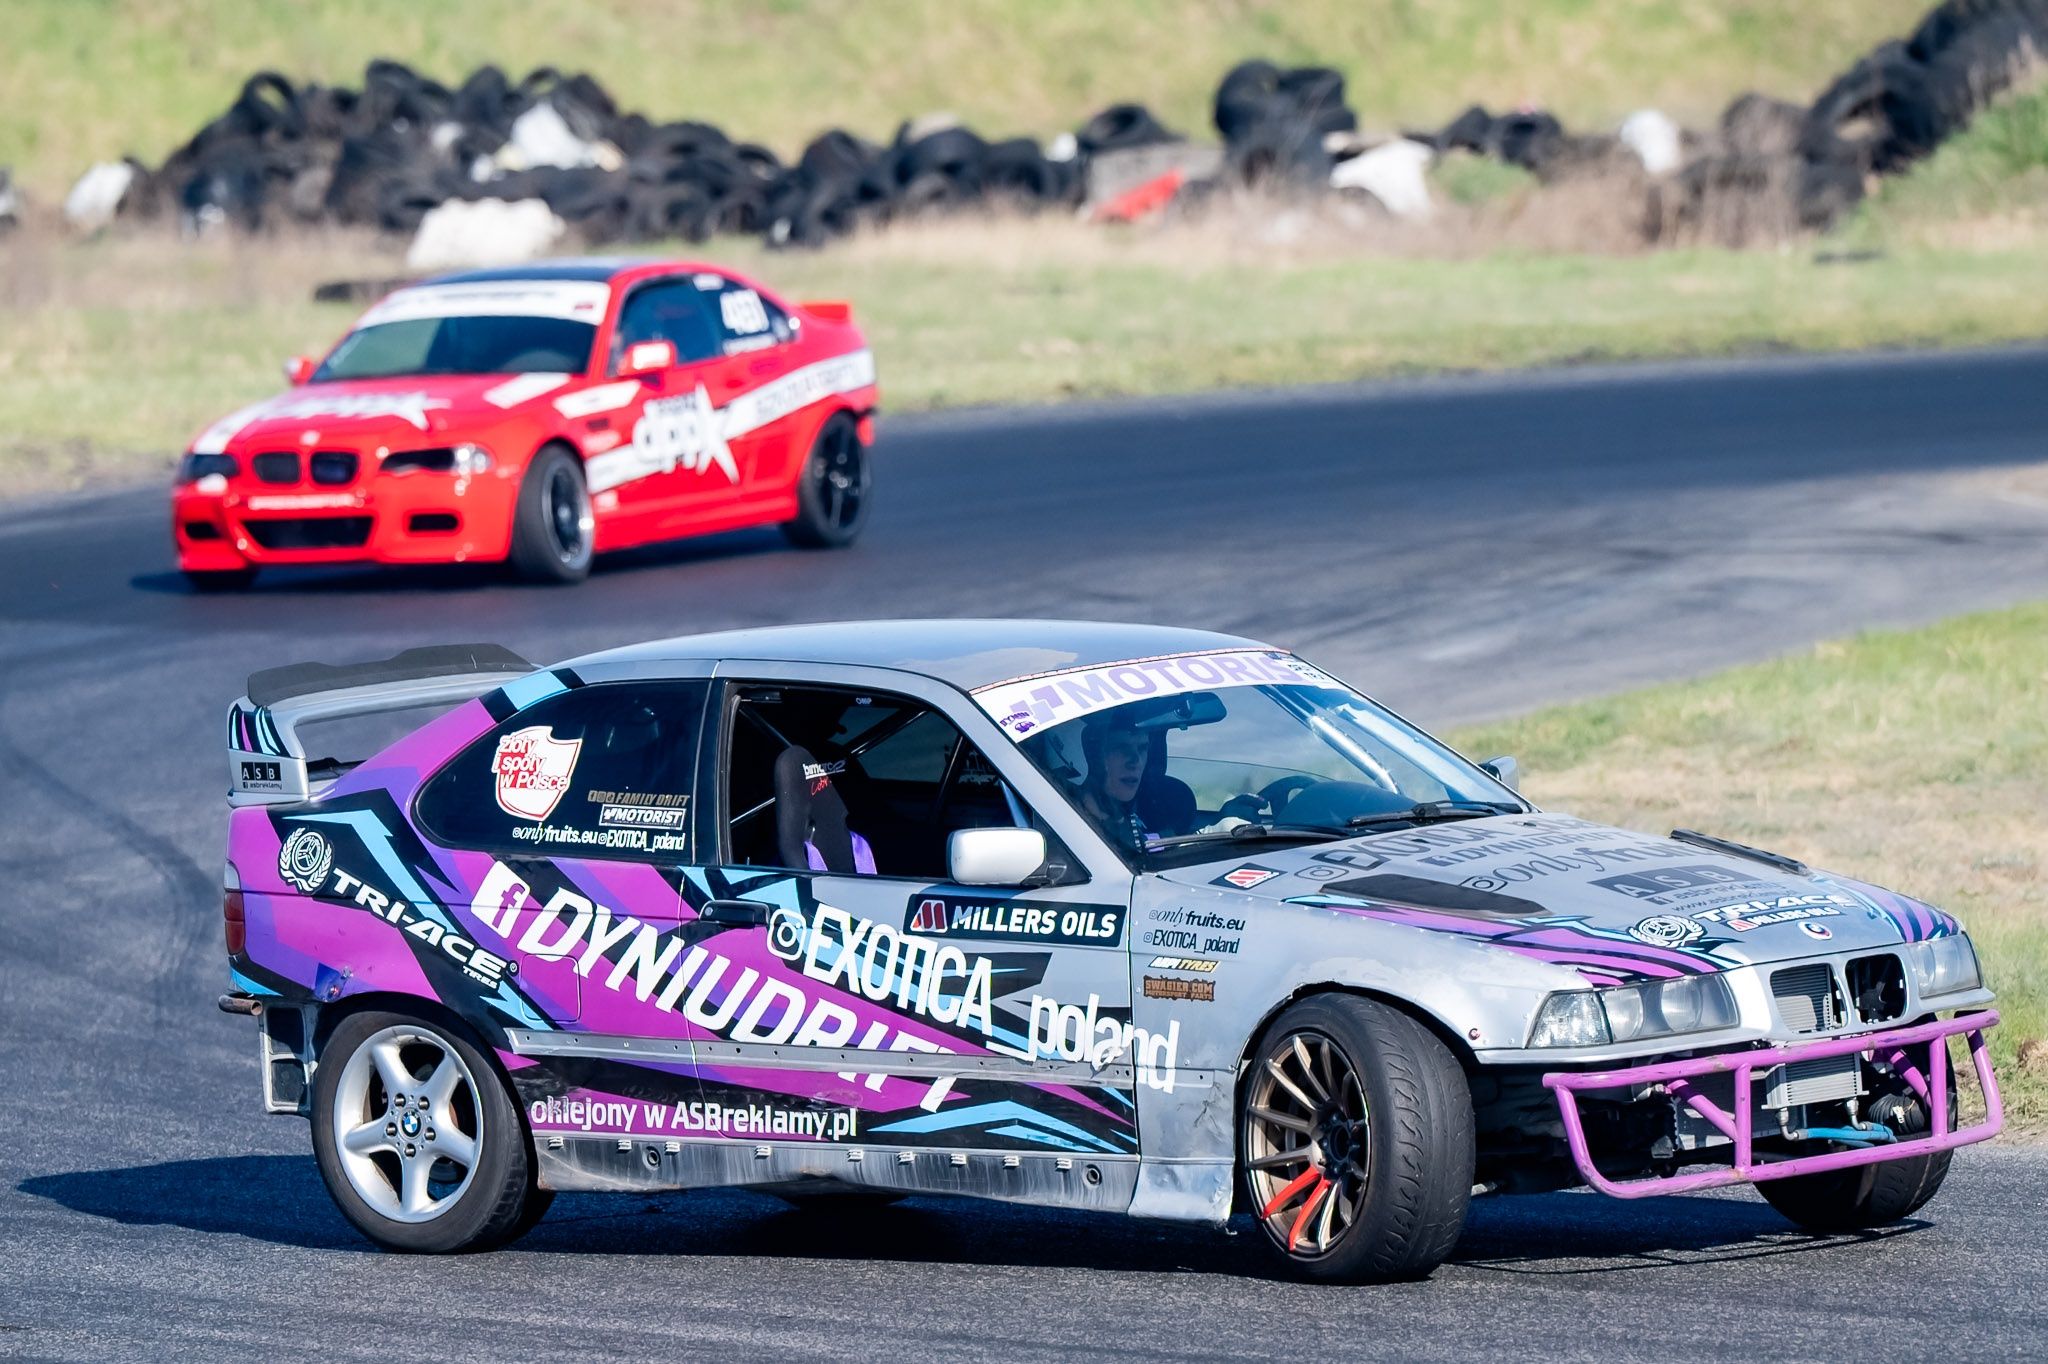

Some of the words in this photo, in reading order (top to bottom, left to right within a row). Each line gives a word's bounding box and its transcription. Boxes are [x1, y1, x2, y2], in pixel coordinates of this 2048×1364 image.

[1057, 656, 1304, 709] MOTORIS
[516, 771, 568, 790] Polsce
[614, 808, 683, 824] MOTORIST
[332, 867, 507, 980] TRI-ACE
[951, 905, 1056, 935] MILLERS
[1061, 911, 1117, 938] OILS
[462, 965, 498, 990] TIRES
[531, 1095, 637, 1132] oklejony
[643, 1104, 667, 1129] w
